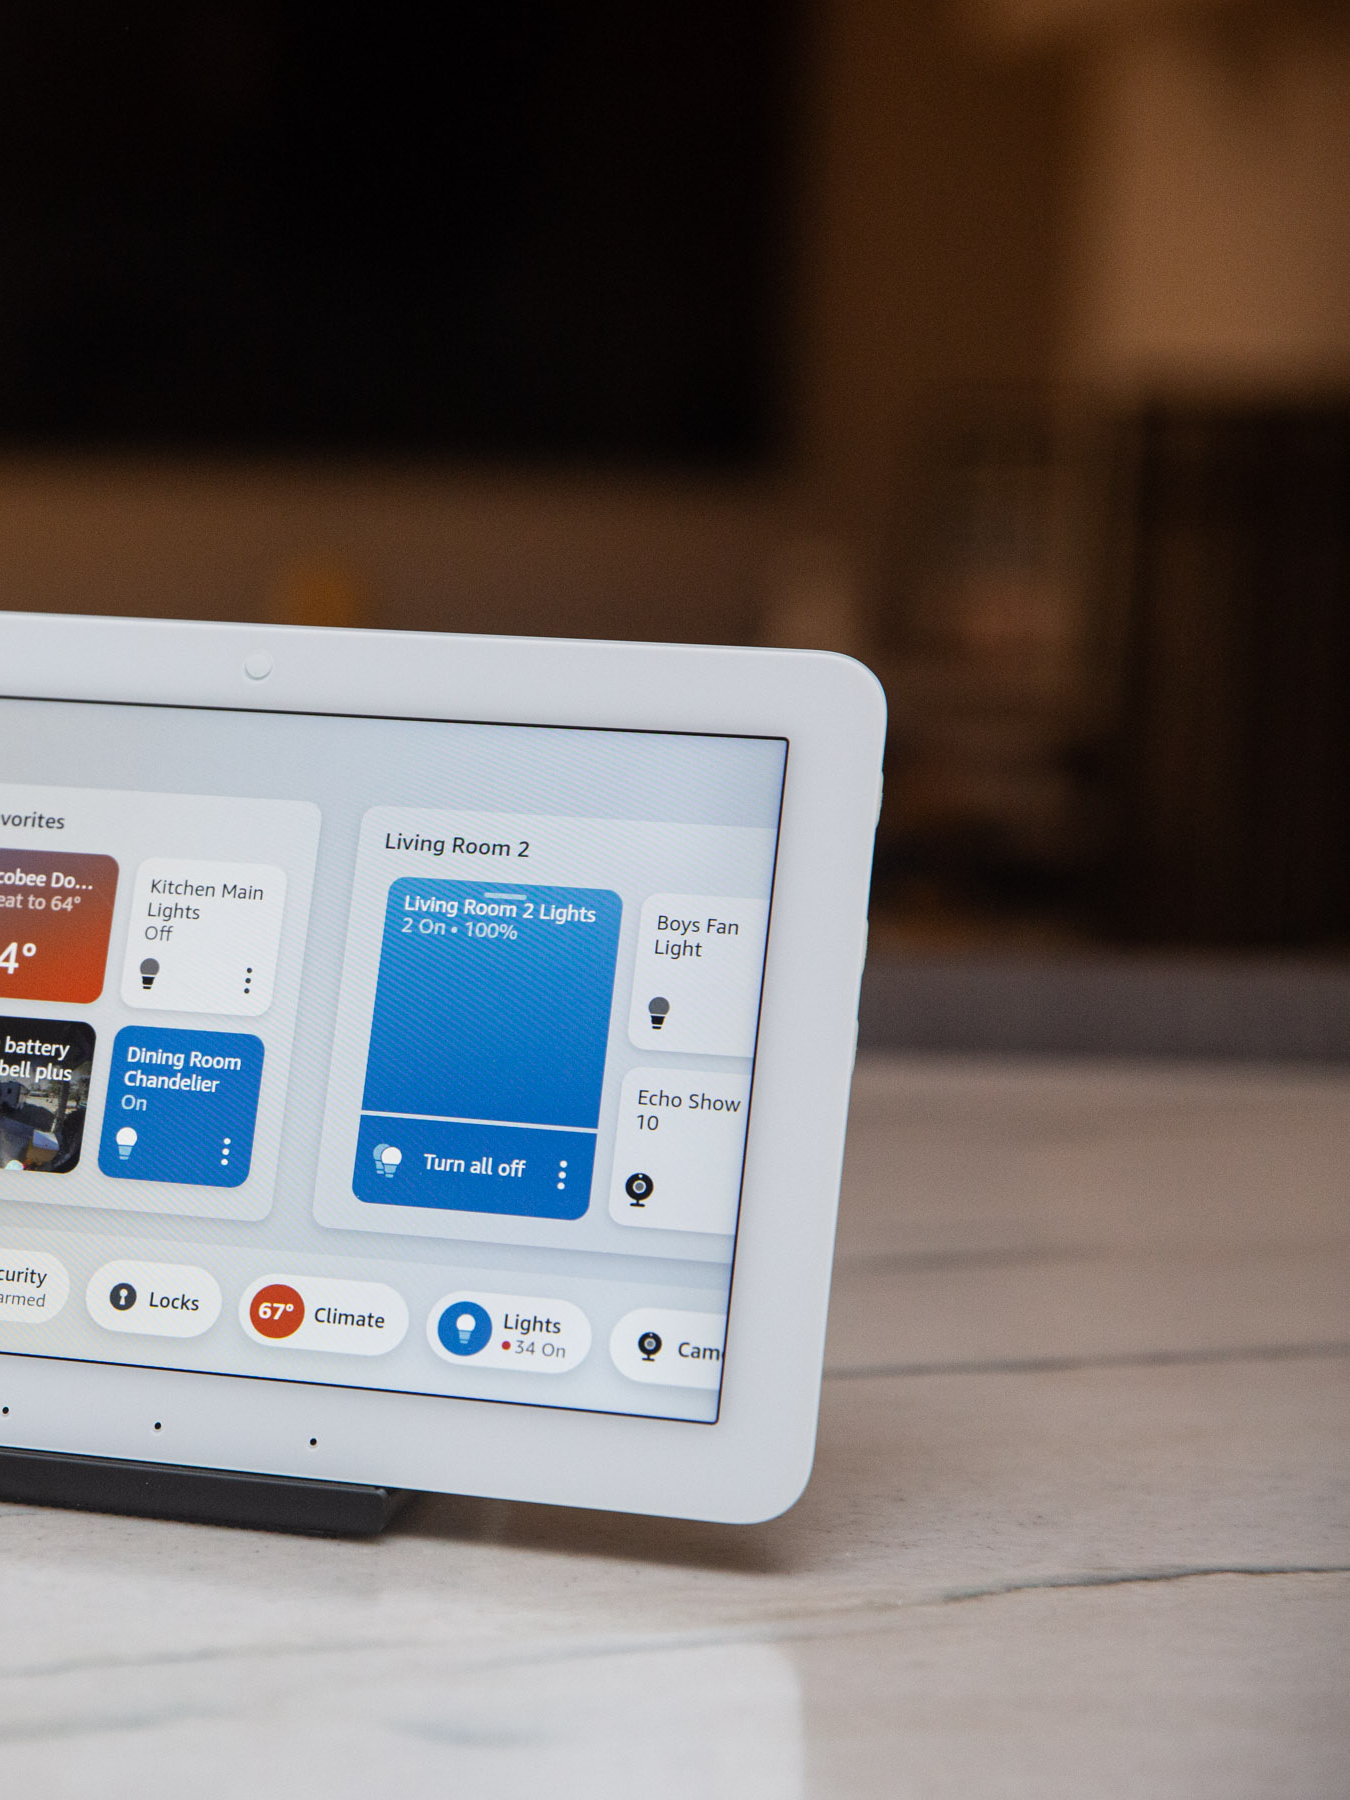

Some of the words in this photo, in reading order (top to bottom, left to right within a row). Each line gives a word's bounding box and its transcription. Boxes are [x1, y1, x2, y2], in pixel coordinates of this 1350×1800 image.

[384, 832, 446, 856] Living
[451, 836, 511, 857] Room
[517, 840, 531, 858] 2
[150, 878, 217, 899] Kitchen
[221, 883, 265, 901] Main
[27, 893, 47, 911] to
[49, 894, 82, 912] 64°
[147, 901, 201, 921] Lights
[403, 894, 458, 918] Living
[462, 898, 518, 919] Room
[522, 902, 535, 919] 2
[539, 904, 597, 925] Lights
[144, 924, 174, 943] Off
[401, 917, 413, 934] 2
[418, 918, 446, 936] On
[465, 921, 518, 941] 100%
[656, 914, 701, 935] Boys
[706, 917, 740, 936] Fan
[653, 938, 703, 961] Light
[4, 1036, 71, 1059] battery
[126, 1045, 185, 1070] Dining
[189, 1051, 243, 1072] Room
[34, 1063, 73, 1083] plus
[123, 1070, 221, 1094] Chandelier
[120, 1093, 148, 1112] On
[637, 1088, 683, 1109] Echo
[688, 1092, 742, 1113] Show
[636, 1113, 660, 1132] 10
[423, 1152, 465, 1174] Turn
[469, 1156, 493, 1176] all
[497, 1159, 527, 1179] off
[148, 1290, 200, 1312] Locks
[257, 1301, 295, 1322] 67°
[313, 1306, 386, 1330] Climate
[503, 1313, 562, 1335] Lights
[514, 1339, 536, 1357] 34
[541, 1342, 567, 1359] On
[677, 1341, 724, 1362] Cam
